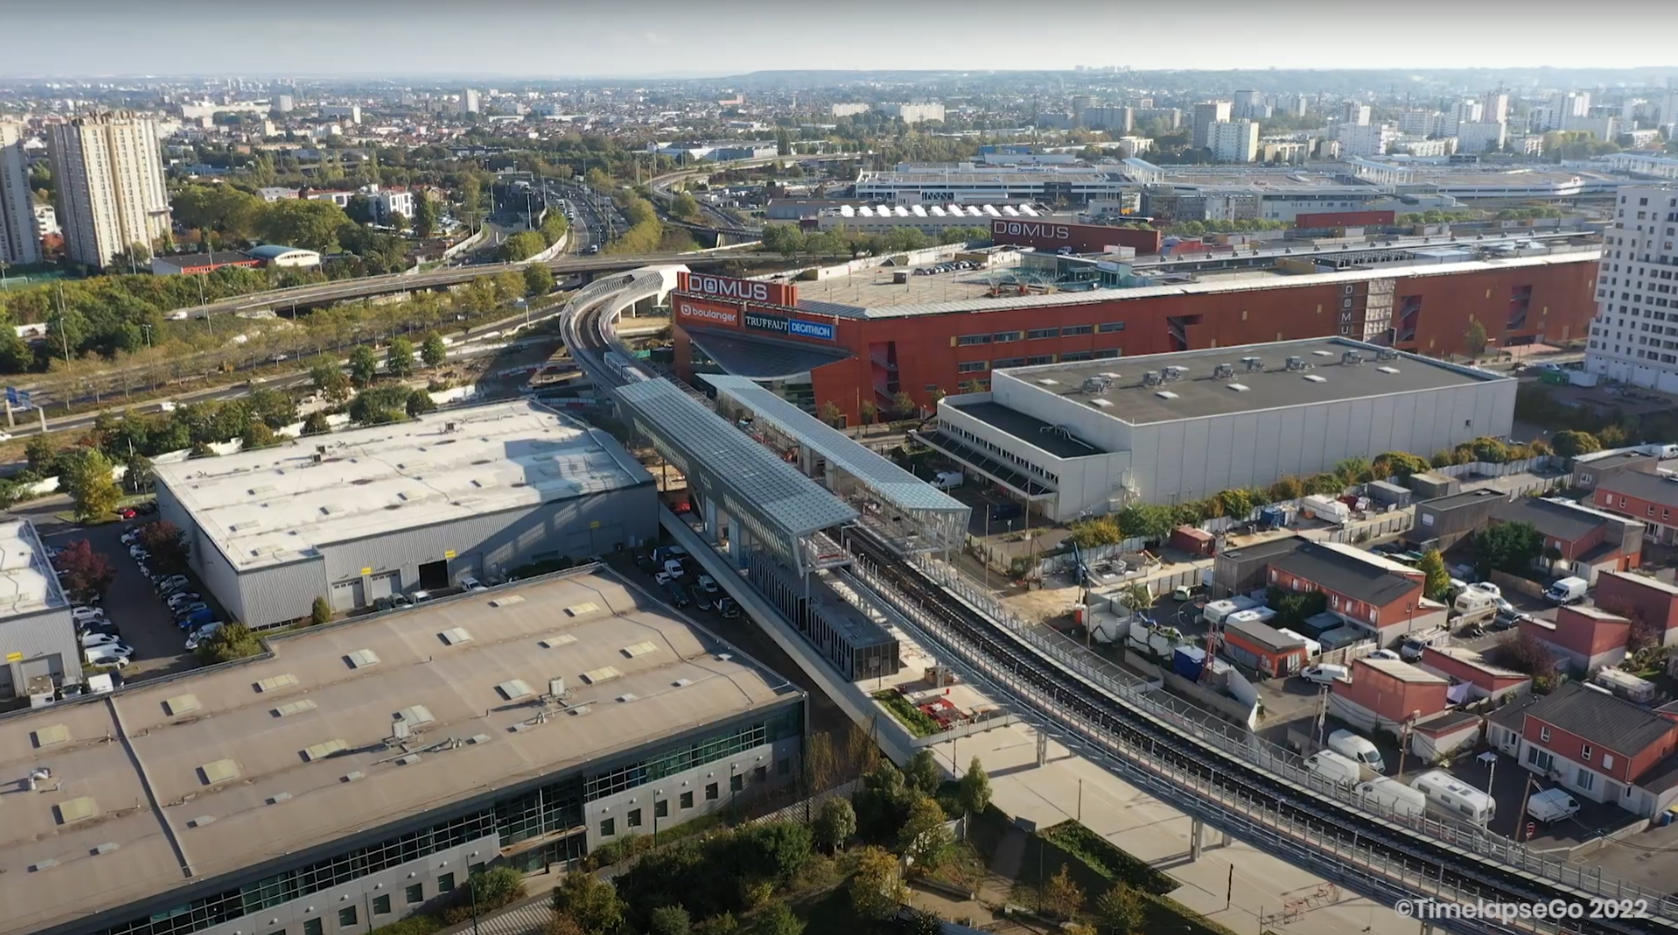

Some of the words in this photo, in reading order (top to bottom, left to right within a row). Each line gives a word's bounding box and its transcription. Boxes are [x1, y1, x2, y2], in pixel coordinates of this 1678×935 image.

[994, 221, 1069, 239] DOMUS
[689, 276, 767, 300] DOMUS
[692, 307, 736, 322] boulanger
[1341, 285, 1353, 335] DOMU
[745, 316, 788, 331] TRUFFAUT
[791, 323, 830, 337] DECATHLON
